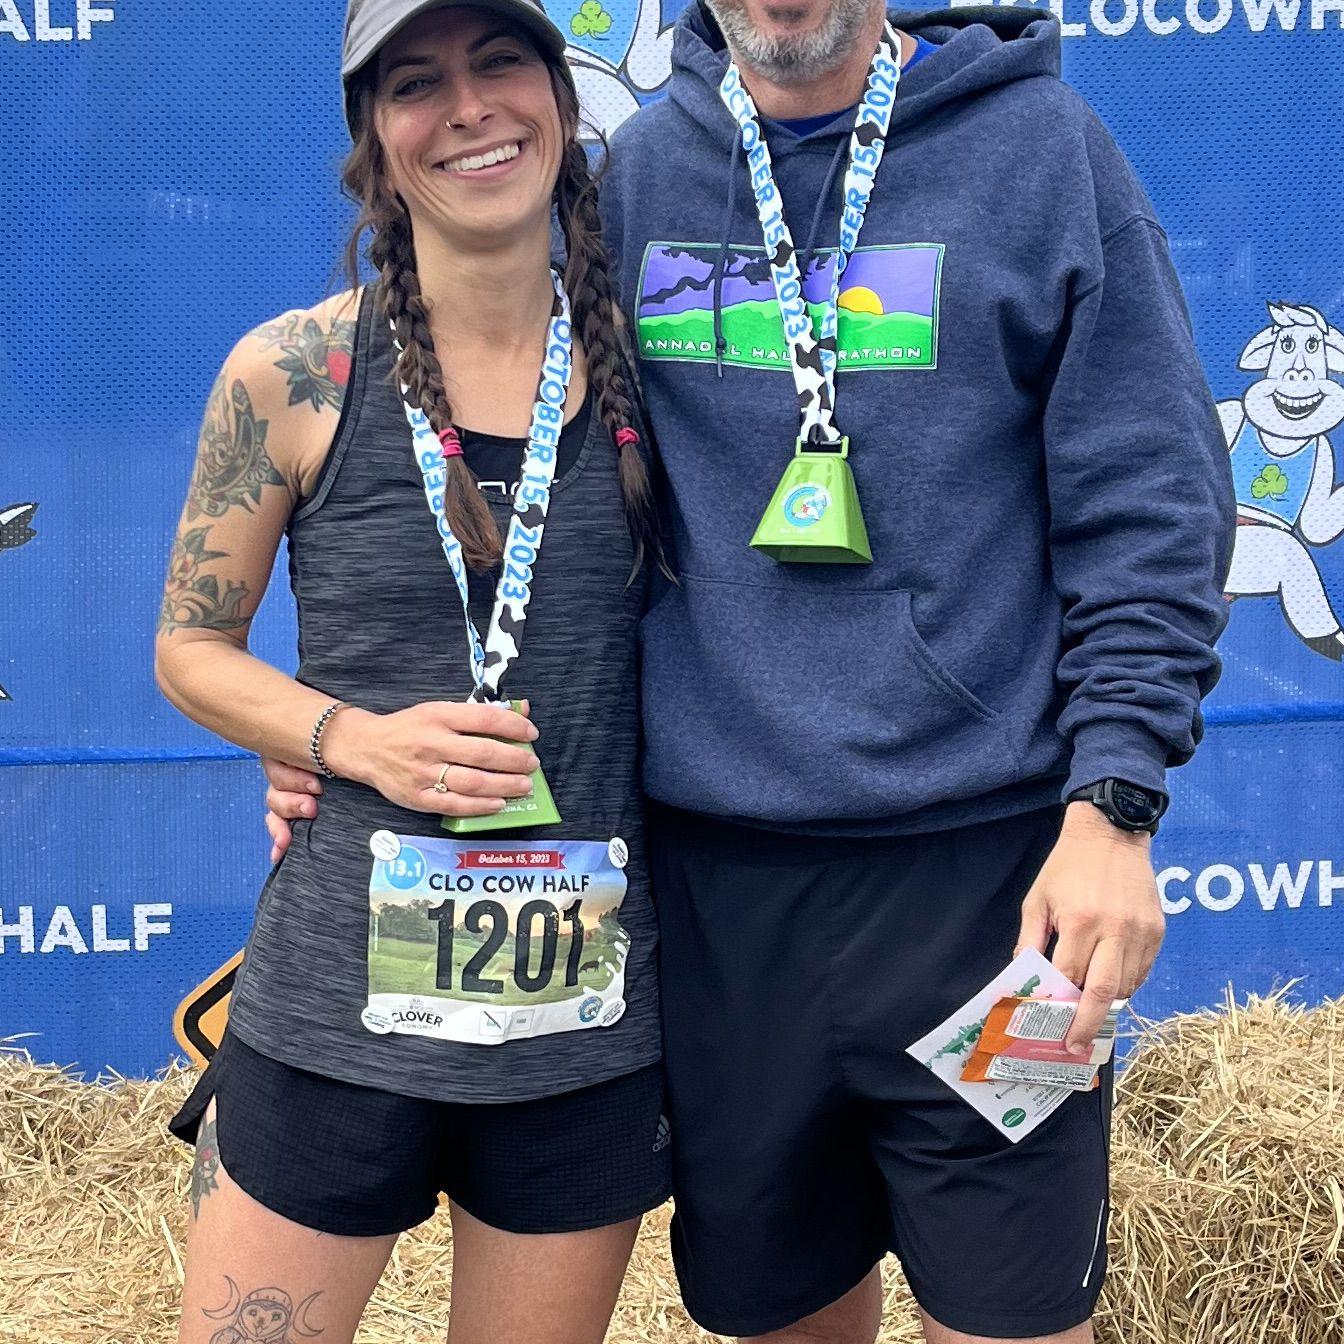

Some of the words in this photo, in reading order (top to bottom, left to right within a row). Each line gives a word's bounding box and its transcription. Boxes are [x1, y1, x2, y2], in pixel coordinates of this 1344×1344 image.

[862, 58, 898, 127] 2023
[723, 69, 775, 205] OCTOBER
[763, 211, 785, 260] 15,
[775, 262, 808, 339] 2023
[645, 339, 741, 356] ANNADL
[752, 347, 790, 361] HAL
[529, 318, 572, 464] OCTOBER
[517, 474, 549, 509] 15,
[502, 524, 539, 599] 2023
[389, 859, 422, 878] 13.1
[429, 873, 474, 892] CLO
[483, 874, 535, 894] COW
[542, 874, 590, 893] HALF
[478, 853, 514, 864] October
[516, 853, 528, 865] 15,
[530, 853, 551, 864] 2023
[427, 898, 583, 995] 1201
